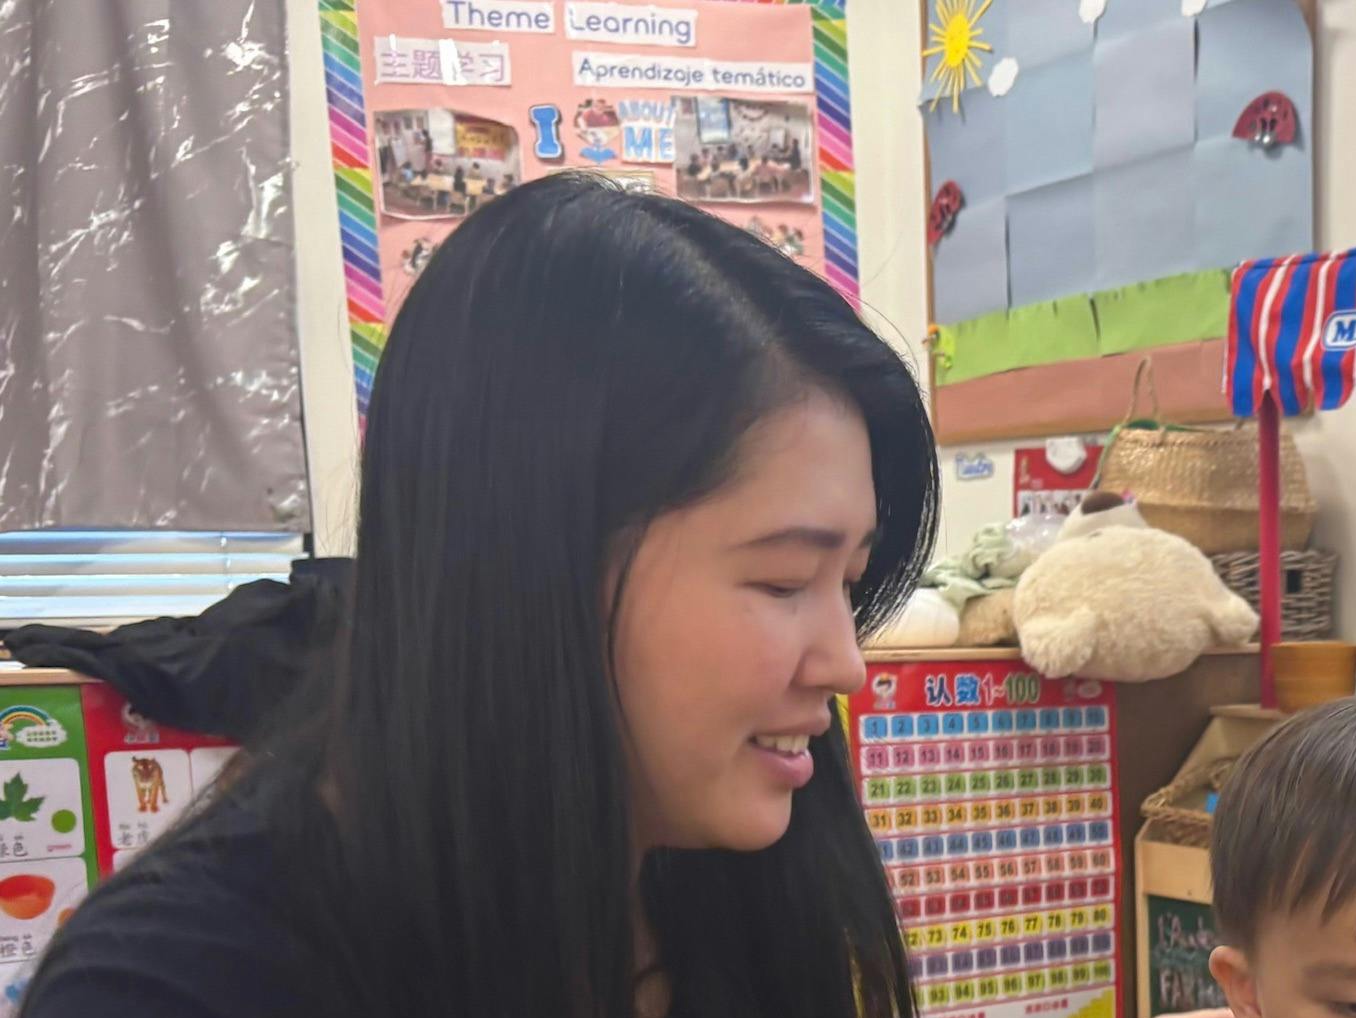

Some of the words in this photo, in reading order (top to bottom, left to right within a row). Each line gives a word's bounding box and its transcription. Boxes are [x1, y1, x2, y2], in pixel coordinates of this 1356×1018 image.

[447, 1, 550, 29] Theme
[568, 8, 691, 44] Learning
[578, 58, 704, 86] Aprendizaje
[712, 67, 806, 88] temático
[624, 127, 673, 159] ME
[870, 752, 882, 765] 11
[896, 750, 909, 763] 12
[922, 749, 935, 762] 13
[947, 749, 960, 760] 14
[972, 746, 984, 758] 15
[1019, 744, 1031, 756] 17
[871, 784, 884, 797] 21
[897, 782, 910, 794] 22
[922, 780, 936, 793] 23
[948, 779, 962, 791] 24
[972, 778, 985, 790] 25
[996, 776, 1009, 788] 26
[1020, 774, 1033, 786] 27
[873, 814, 887, 827] 31
[898, 812, 912, 825] 32
[923, 811, 937, 823] 33
[949, 809, 962, 821] 34
[973, 807, 987, 820] 35
[997, 806, 1011, 818] 36
[1021, 803, 1033, 815] 37
[1045, 802, 1057, 814] 38
[900, 873, 914, 886] 52
[926, 871, 939, 884] 53
[951, 869, 964, 880] 54
[975, 866, 989, 878] 55
[1000, 864, 1013, 876] 56
[1023, 861, 1037, 873] 57
[1070, 857, 1083, 869] 59
[928, 930, 942, 942] 73
[953, 926, 966, 938] 74
[977, 924, 991, 936] 75
[1001, 921, 1015, 934] 76
[1025, 918, 1039, 931] 77
[1048, 915, 1061, 927] 78
[1071, 913, 1084, 925] 79
[931, 988, 944, 1000] 93
[955, 986, 969, 998] 94
[980, 982, 993, 995] 95
[1027, 975, 1041, 988] 97
